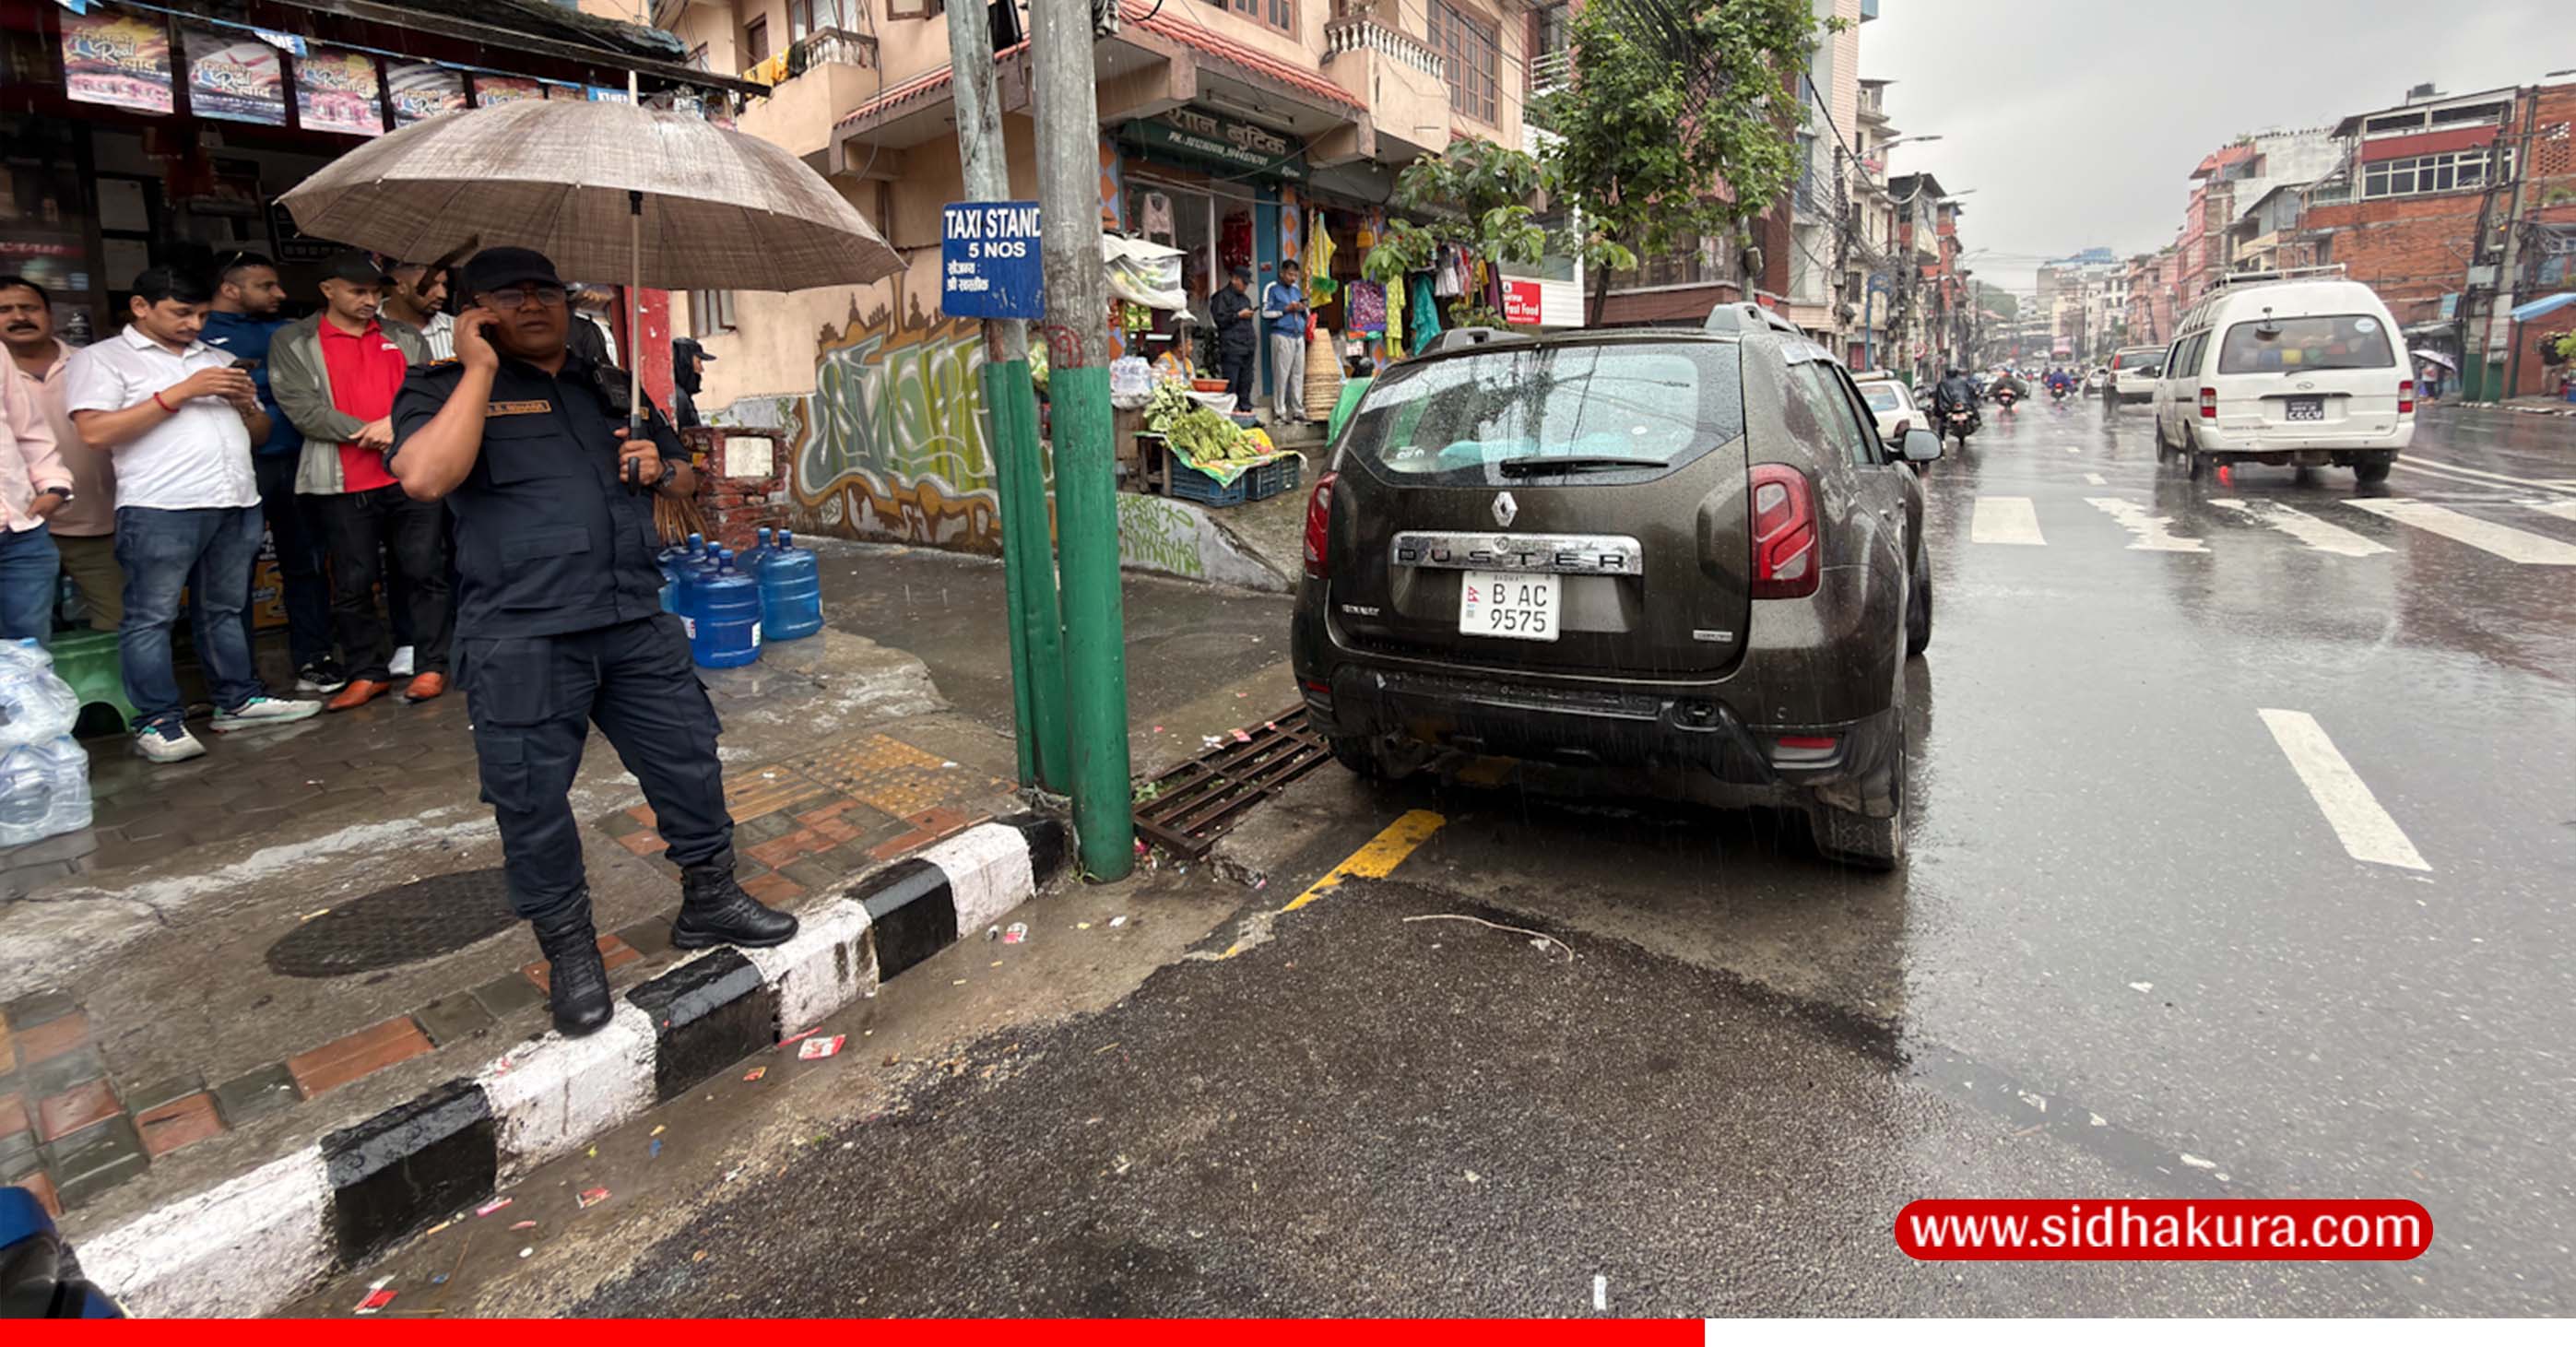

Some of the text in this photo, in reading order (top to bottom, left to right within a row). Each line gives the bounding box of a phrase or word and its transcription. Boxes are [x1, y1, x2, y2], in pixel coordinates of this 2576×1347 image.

[945, 208, 1042, 239] TAXI STAND
[968, 242, 1026, 258] 5 NOS
[1505, 301, 1539, 316] Fast Food
[1398, 549, 1624, 568] DUSTER
[1493, 583, 1547, 607] B AC
[1490, 609, 1547, 632] 9575
